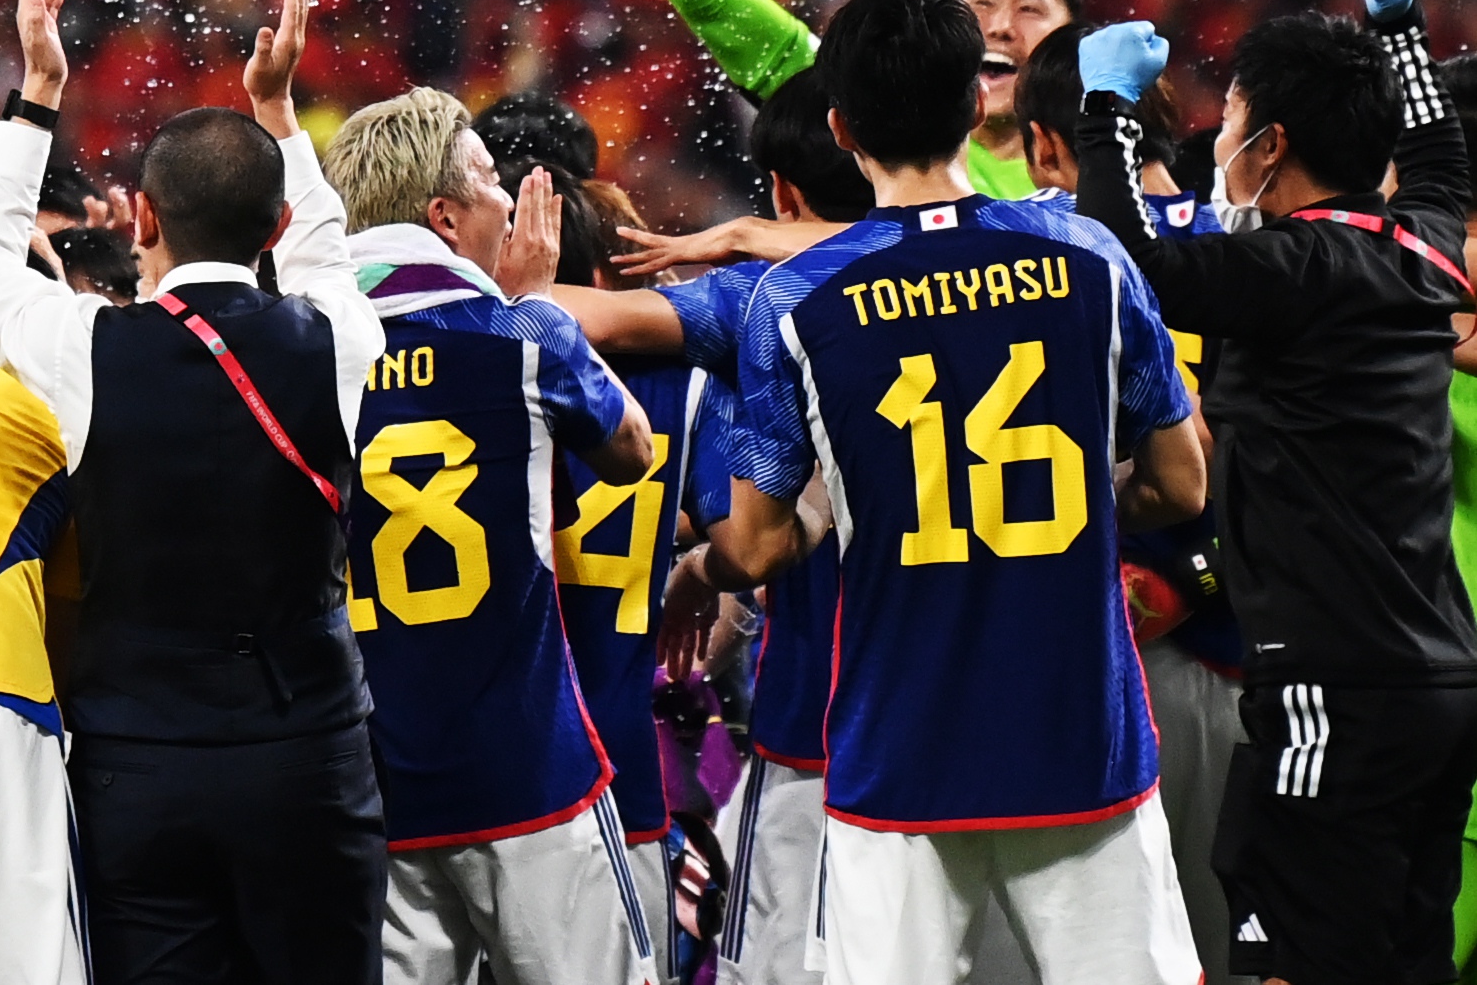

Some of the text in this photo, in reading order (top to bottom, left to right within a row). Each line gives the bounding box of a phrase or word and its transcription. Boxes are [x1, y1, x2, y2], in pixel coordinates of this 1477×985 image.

[843, 256, 1070, 326] TOMIYASU
[257, 406, 278, 435] WORLD
[274, 433, 288, 448] CUP
[875, 340, 1088, 566] 16
